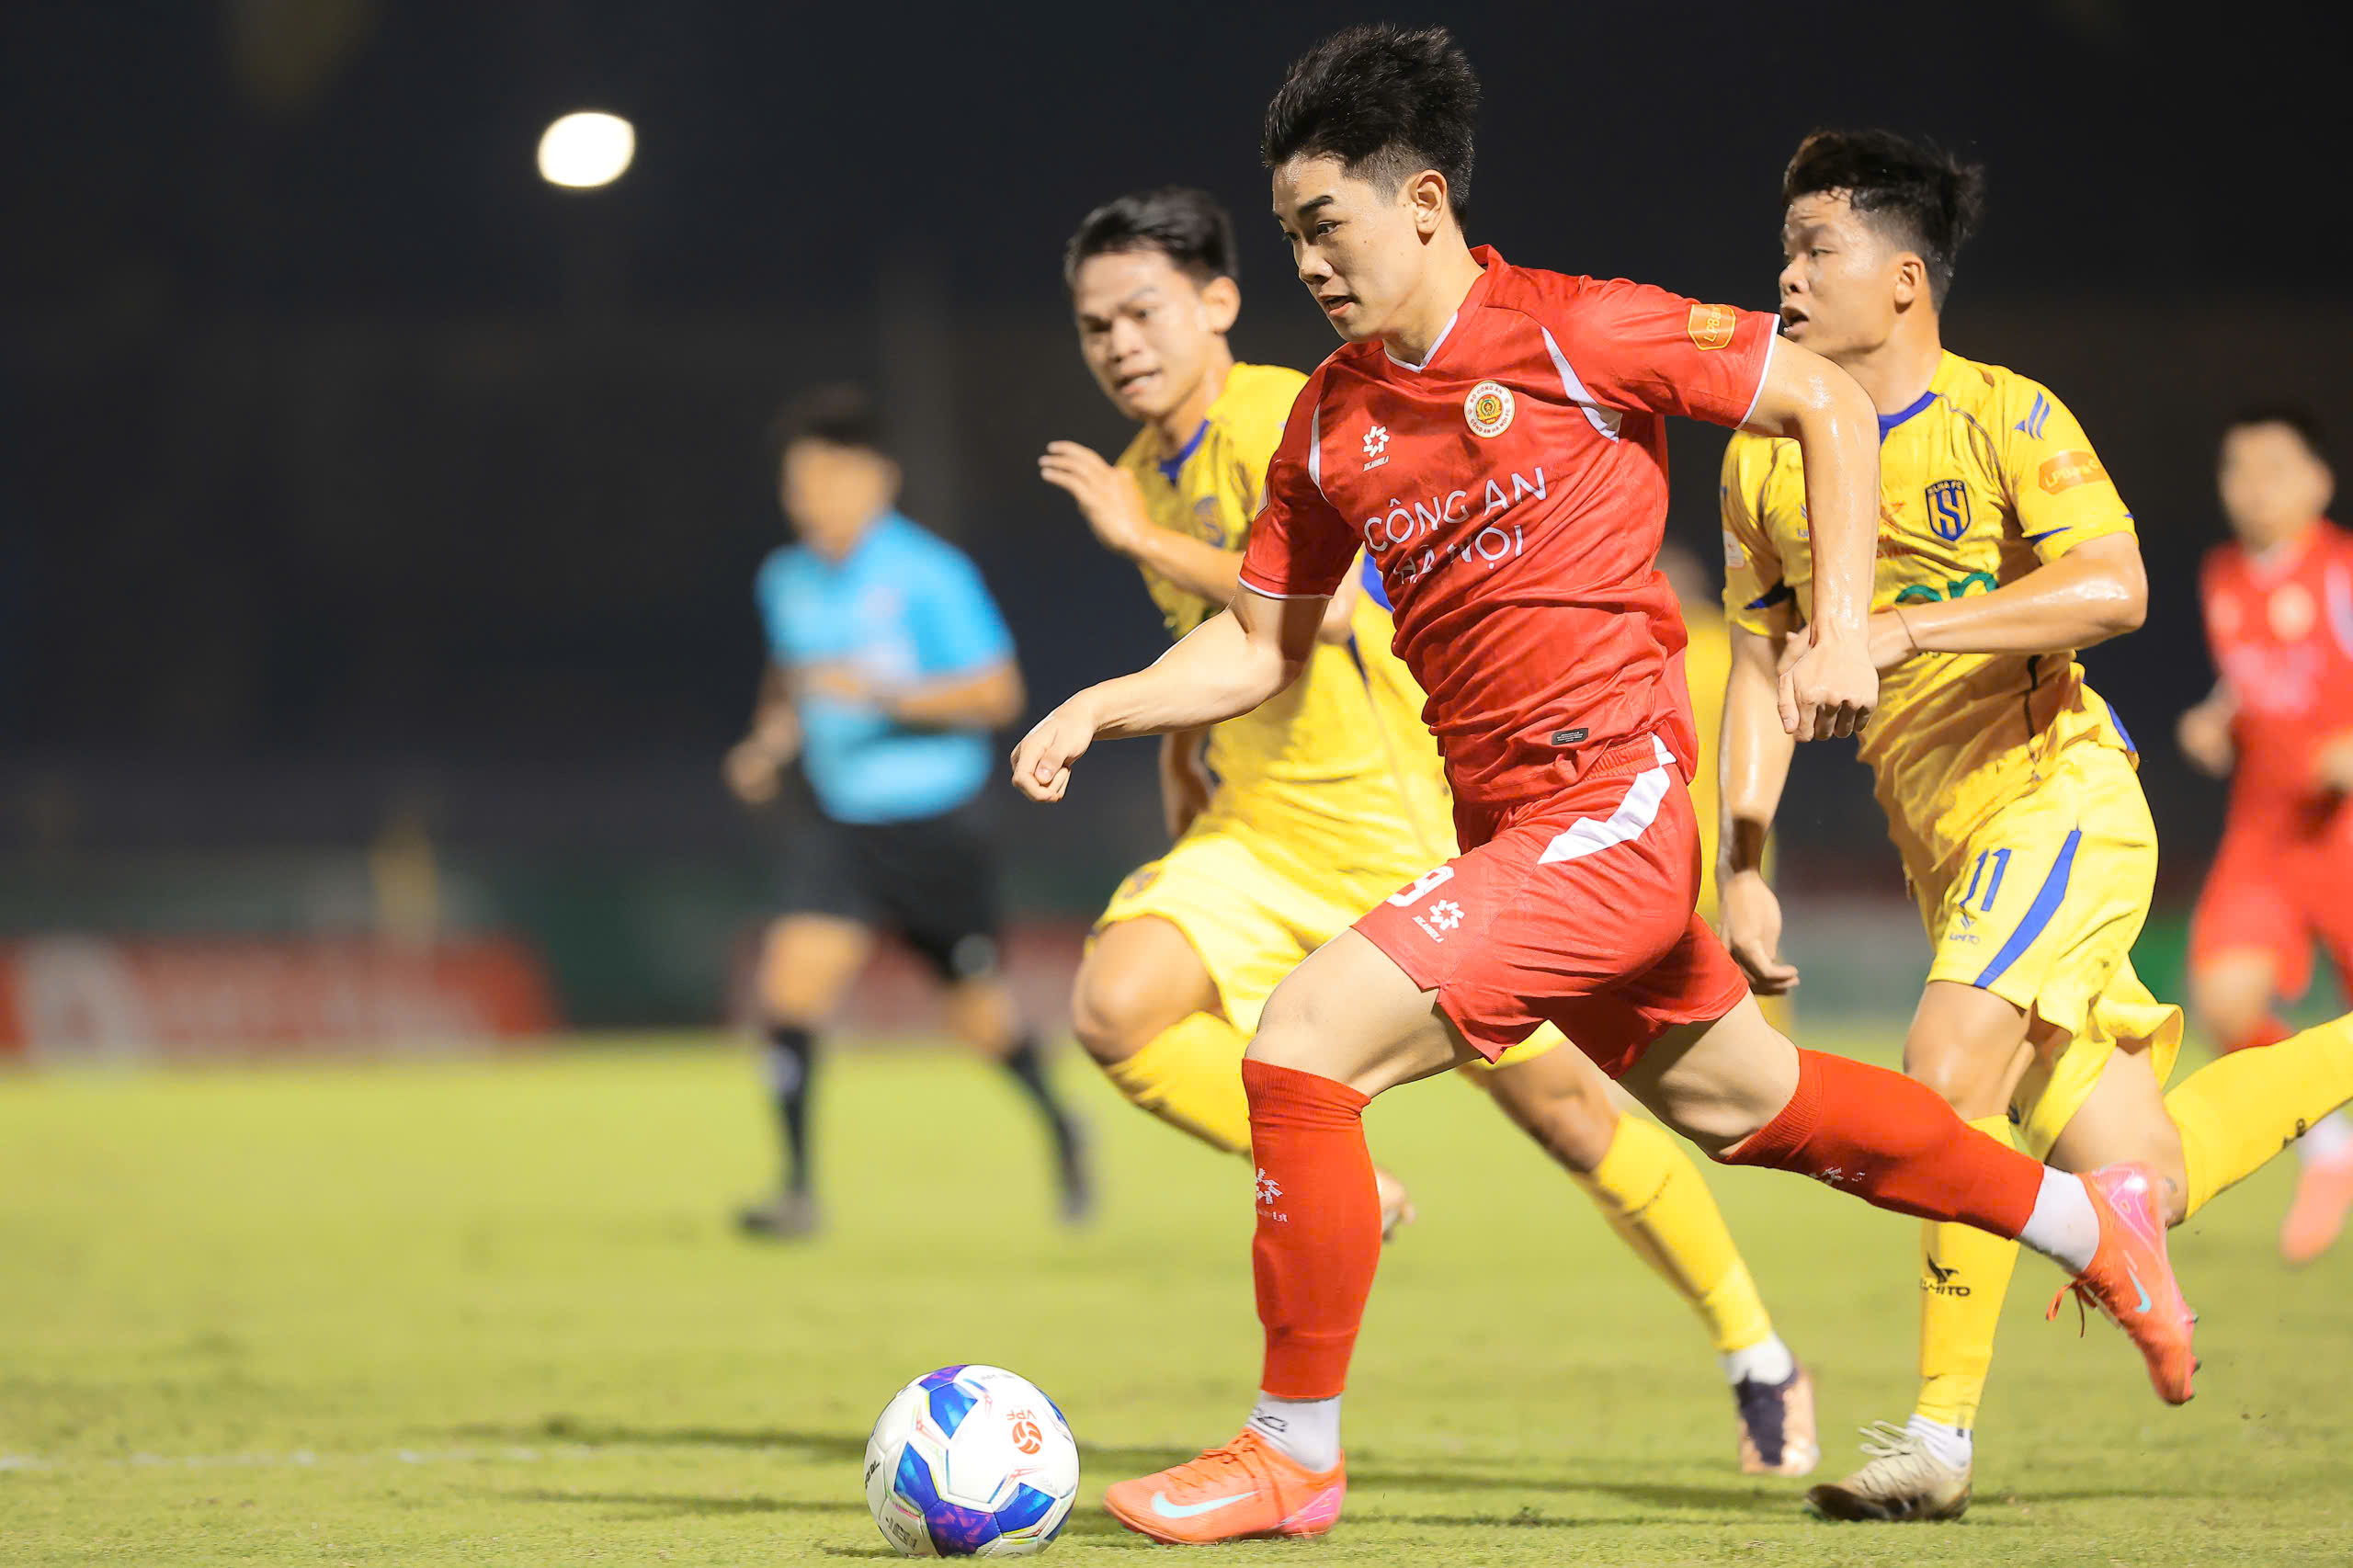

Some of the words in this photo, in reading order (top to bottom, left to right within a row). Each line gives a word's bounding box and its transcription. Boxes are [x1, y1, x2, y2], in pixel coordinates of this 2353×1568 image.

[1364, 489, 1471, 552] CÔNG
[1483, 467, 1548, 517] AN
[1959, 847, 2013, 913] 11
